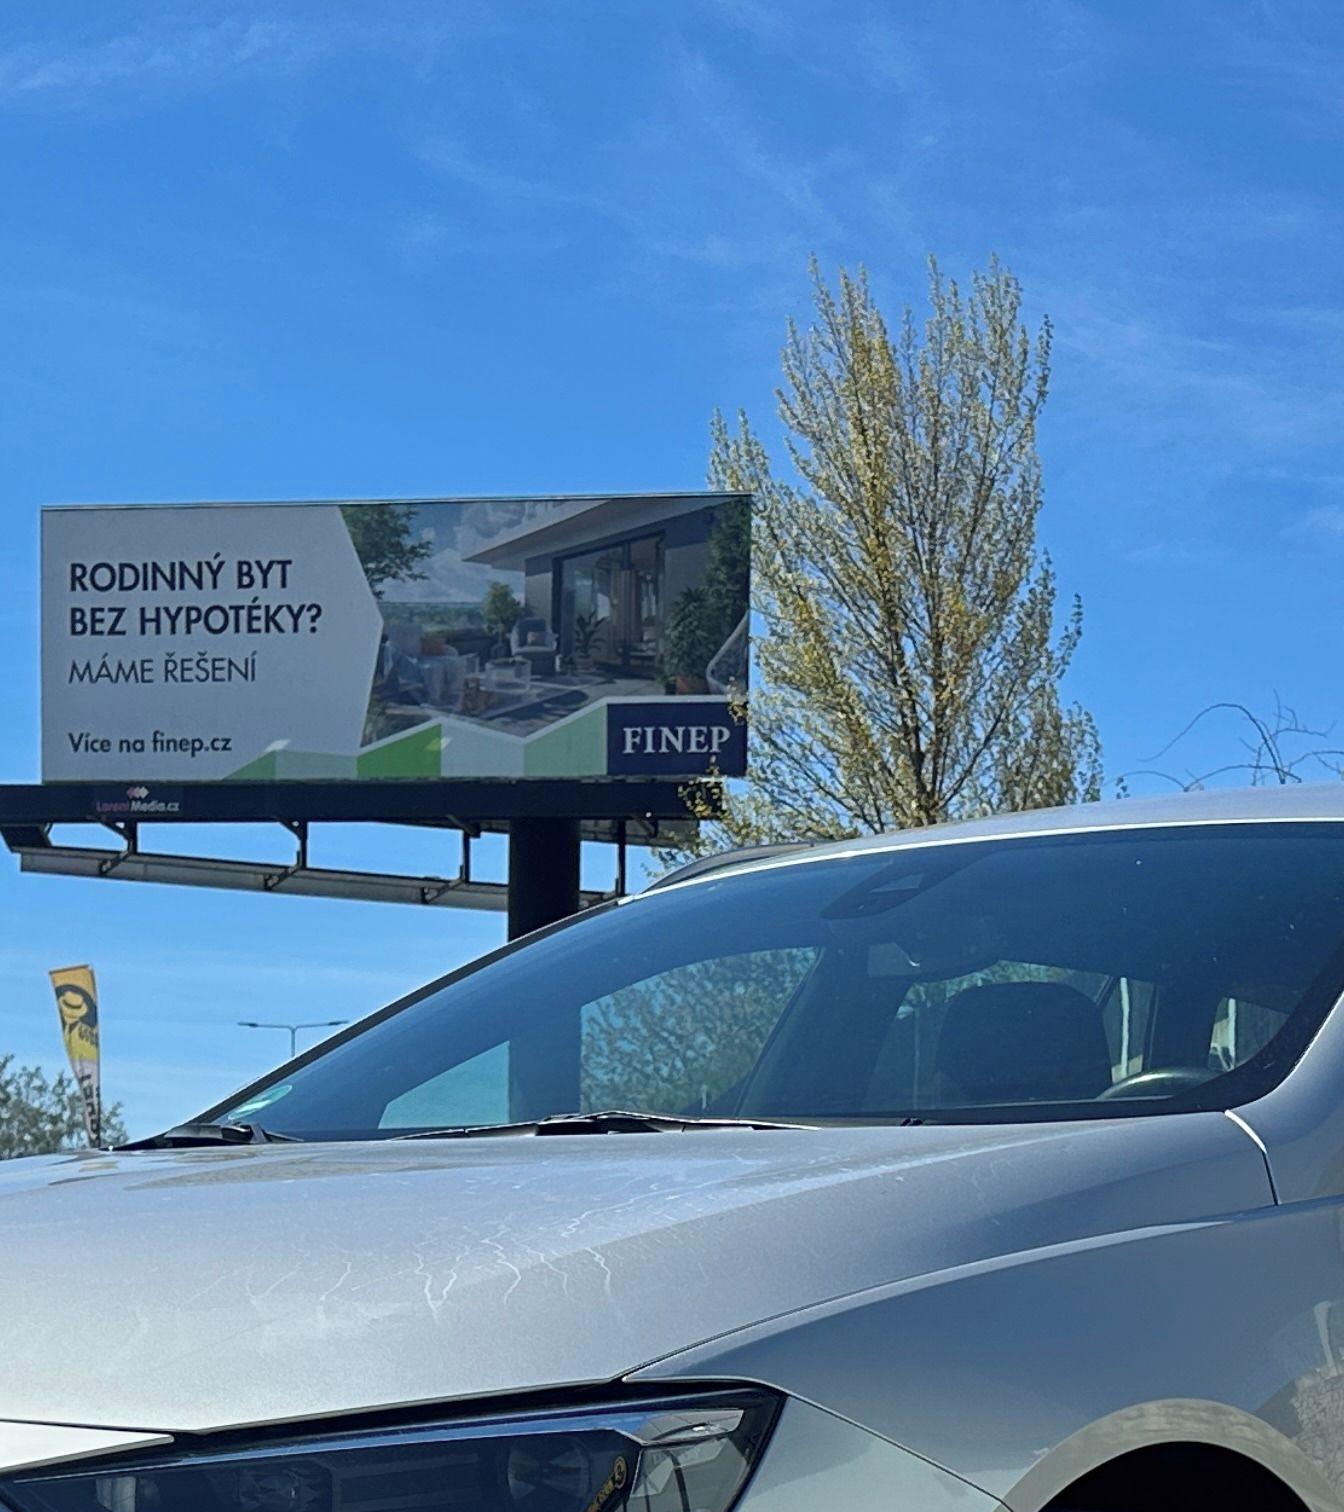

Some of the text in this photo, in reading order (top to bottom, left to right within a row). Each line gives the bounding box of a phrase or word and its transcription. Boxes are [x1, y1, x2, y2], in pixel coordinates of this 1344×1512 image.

[70, 552, 292, 592] RODINNÝ BYT
[70, 596, 322, 636] BEZ HYPOTÉKY?
[68, 650, 258, 683] MÁME ŘEŠENÍ
[68, 730, 232, 757] Více na finep.cz
[622, 726, 730, 753] FINEP
